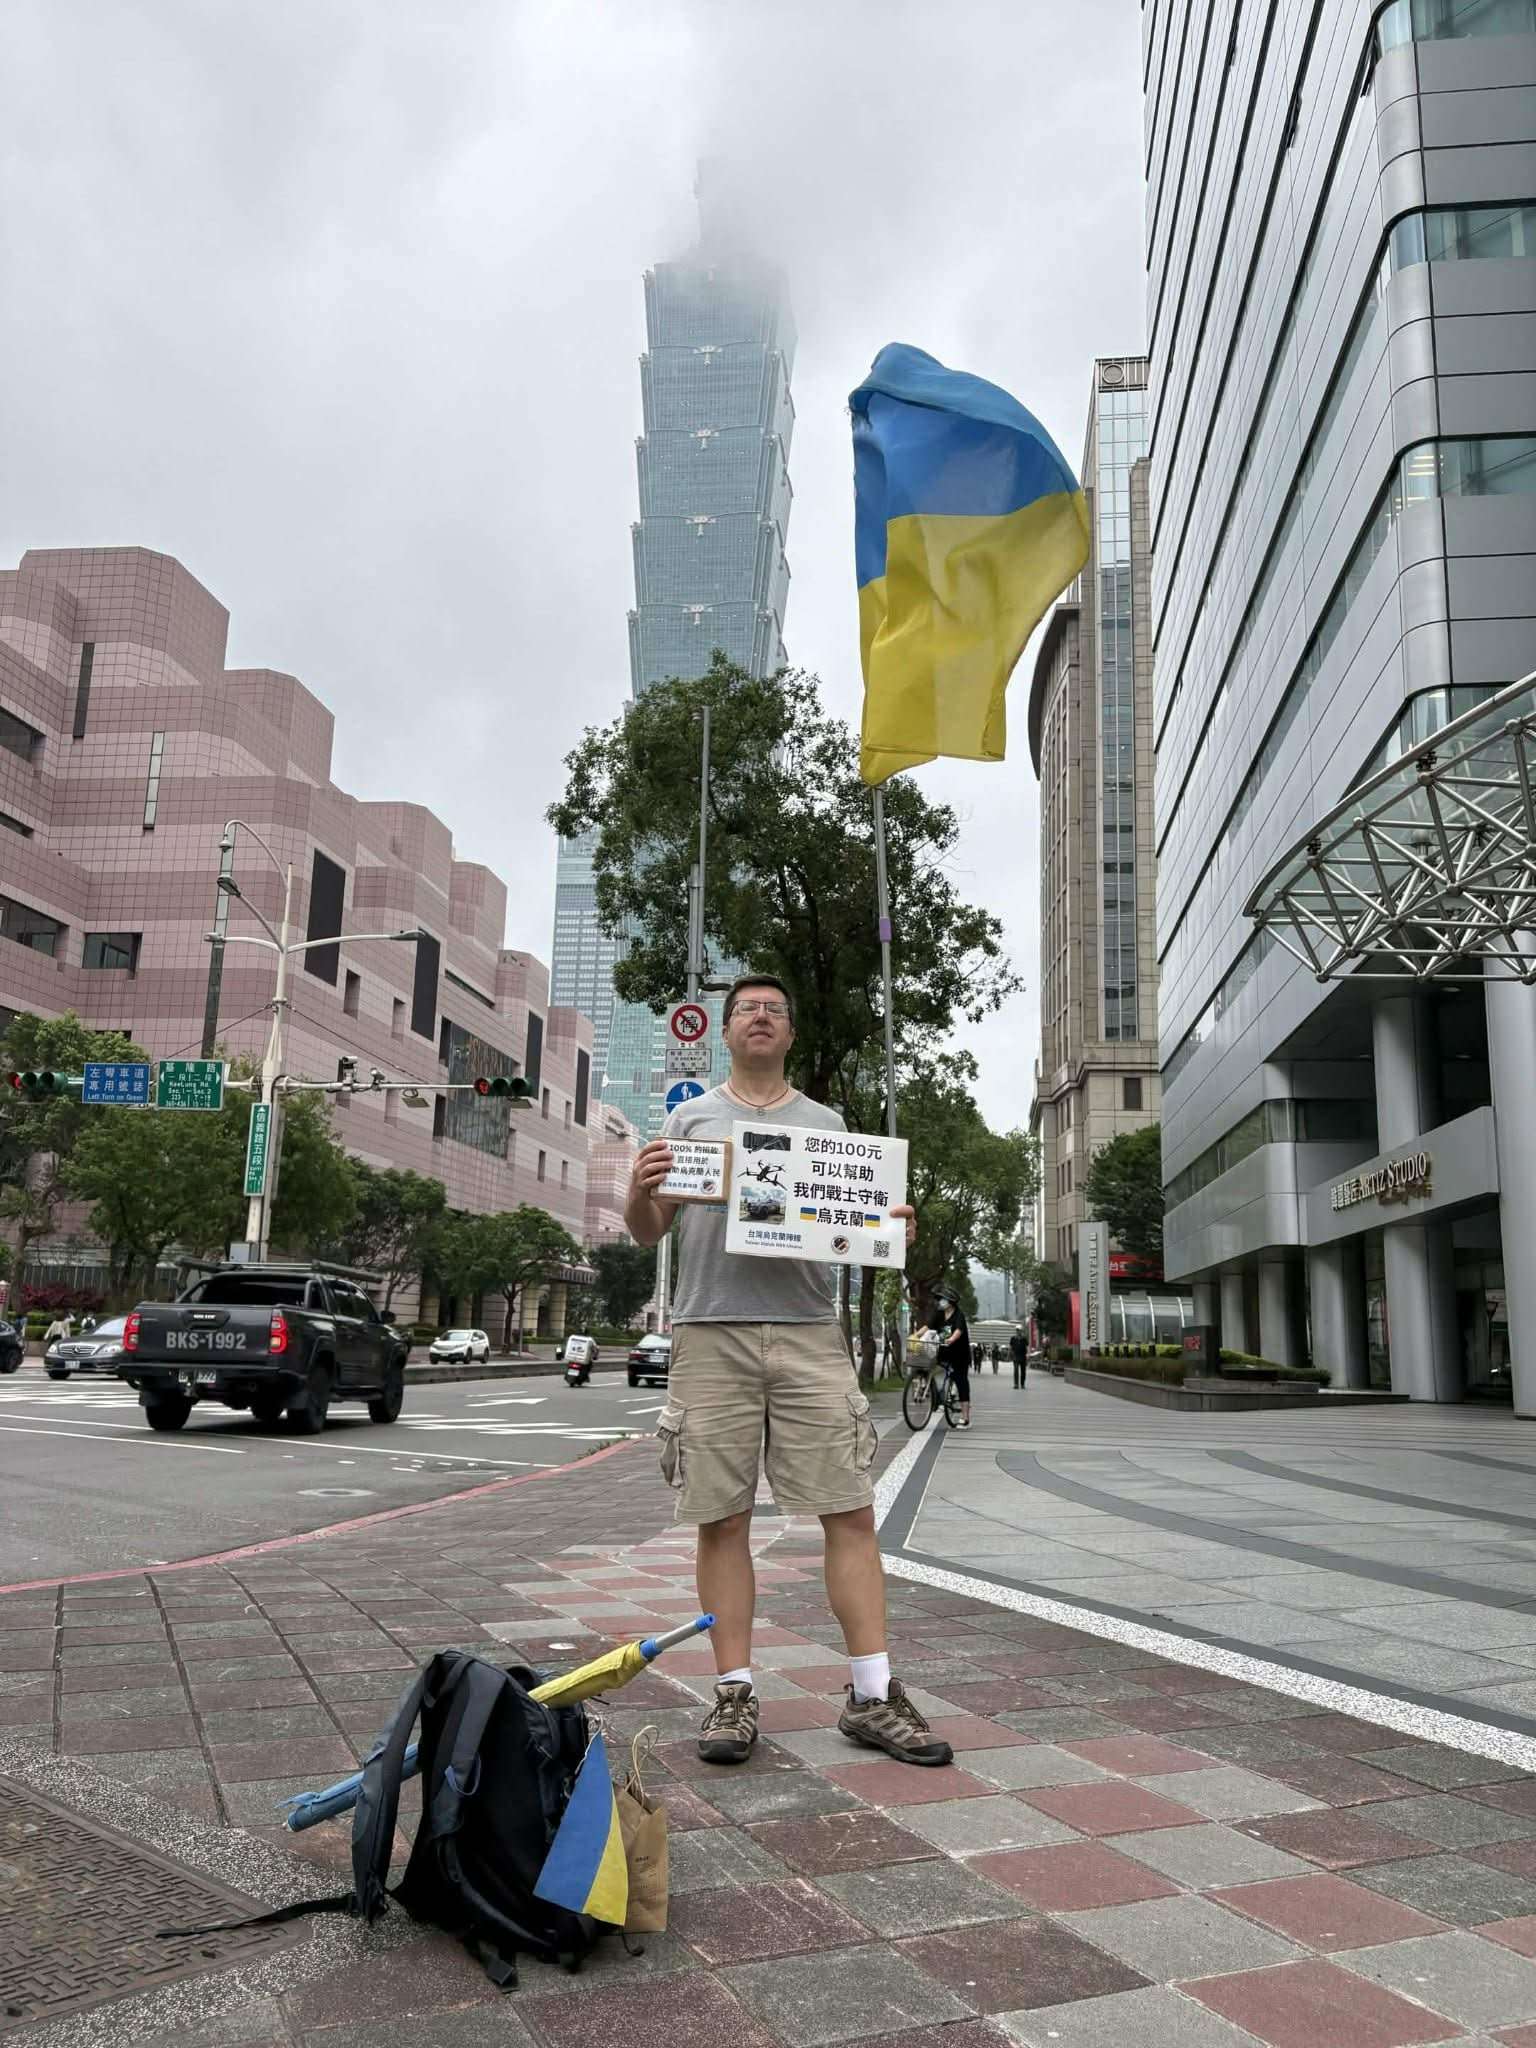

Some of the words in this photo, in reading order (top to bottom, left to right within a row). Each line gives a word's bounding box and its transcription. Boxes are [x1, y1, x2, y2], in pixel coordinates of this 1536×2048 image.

[670, 1144, 692, 1152] 100%
[804, 1136, 882, 1160] 您的100元
[811, 1160, 874, 1182] 可以幫助
[1358, 1169, 1386, 1201] ARTIZ
[1387, 1152, 1427, 1188] STUDIO
[793, 1181, 889, 1207] 我們戰士守衛
[816, 1207, 864, 1228] 烏克蘭
[166, 1331, 247, 1350] BKS-1992
